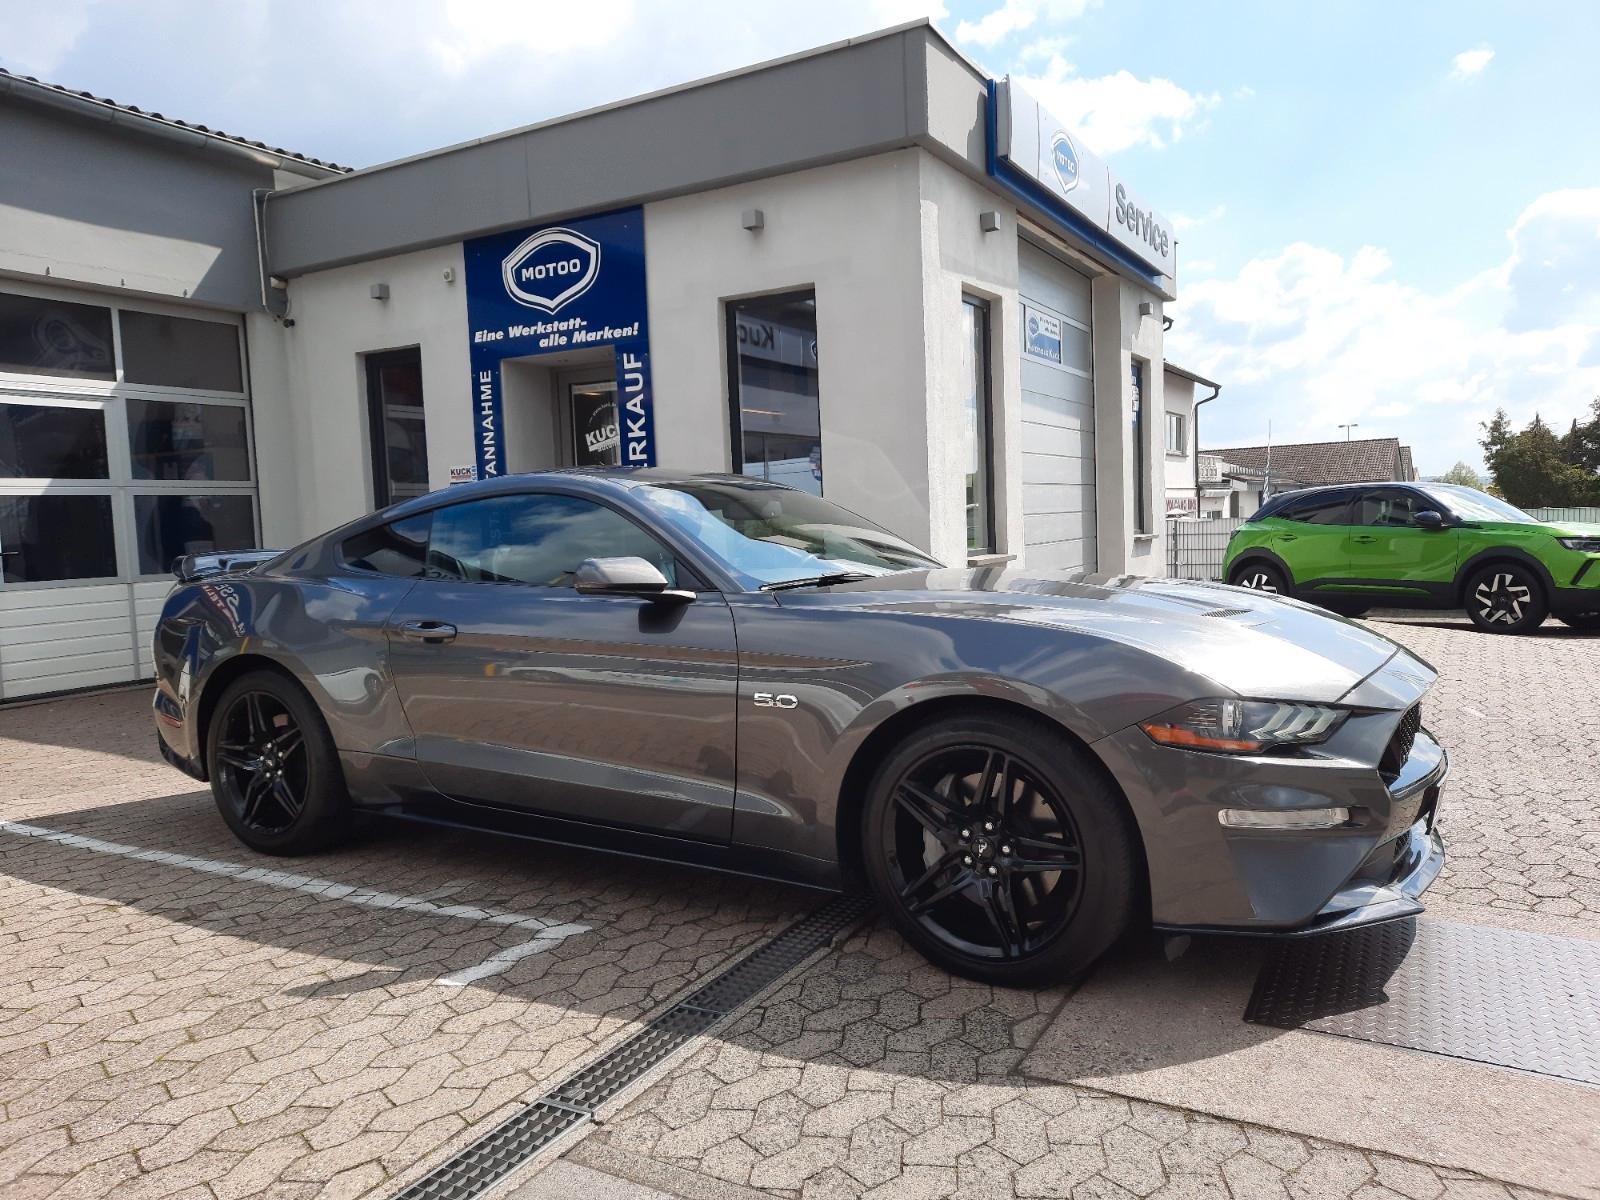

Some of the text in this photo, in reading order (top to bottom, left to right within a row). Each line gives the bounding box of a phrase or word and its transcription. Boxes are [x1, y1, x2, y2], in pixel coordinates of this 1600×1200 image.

[1115, 182, 1169, 257] Service
[521, 258, 581, 282] MOTOO
[474, 317, 587, 343] Eine Werkstatt-
[539, 322, 639, 348] alle Marken!
[479, 369, 497, 480] ANNAHME
[585, 423, 620, 446] KUC
[450, 467, 471, 476] KUCK
[753, 692, 799, 709] 5.0
